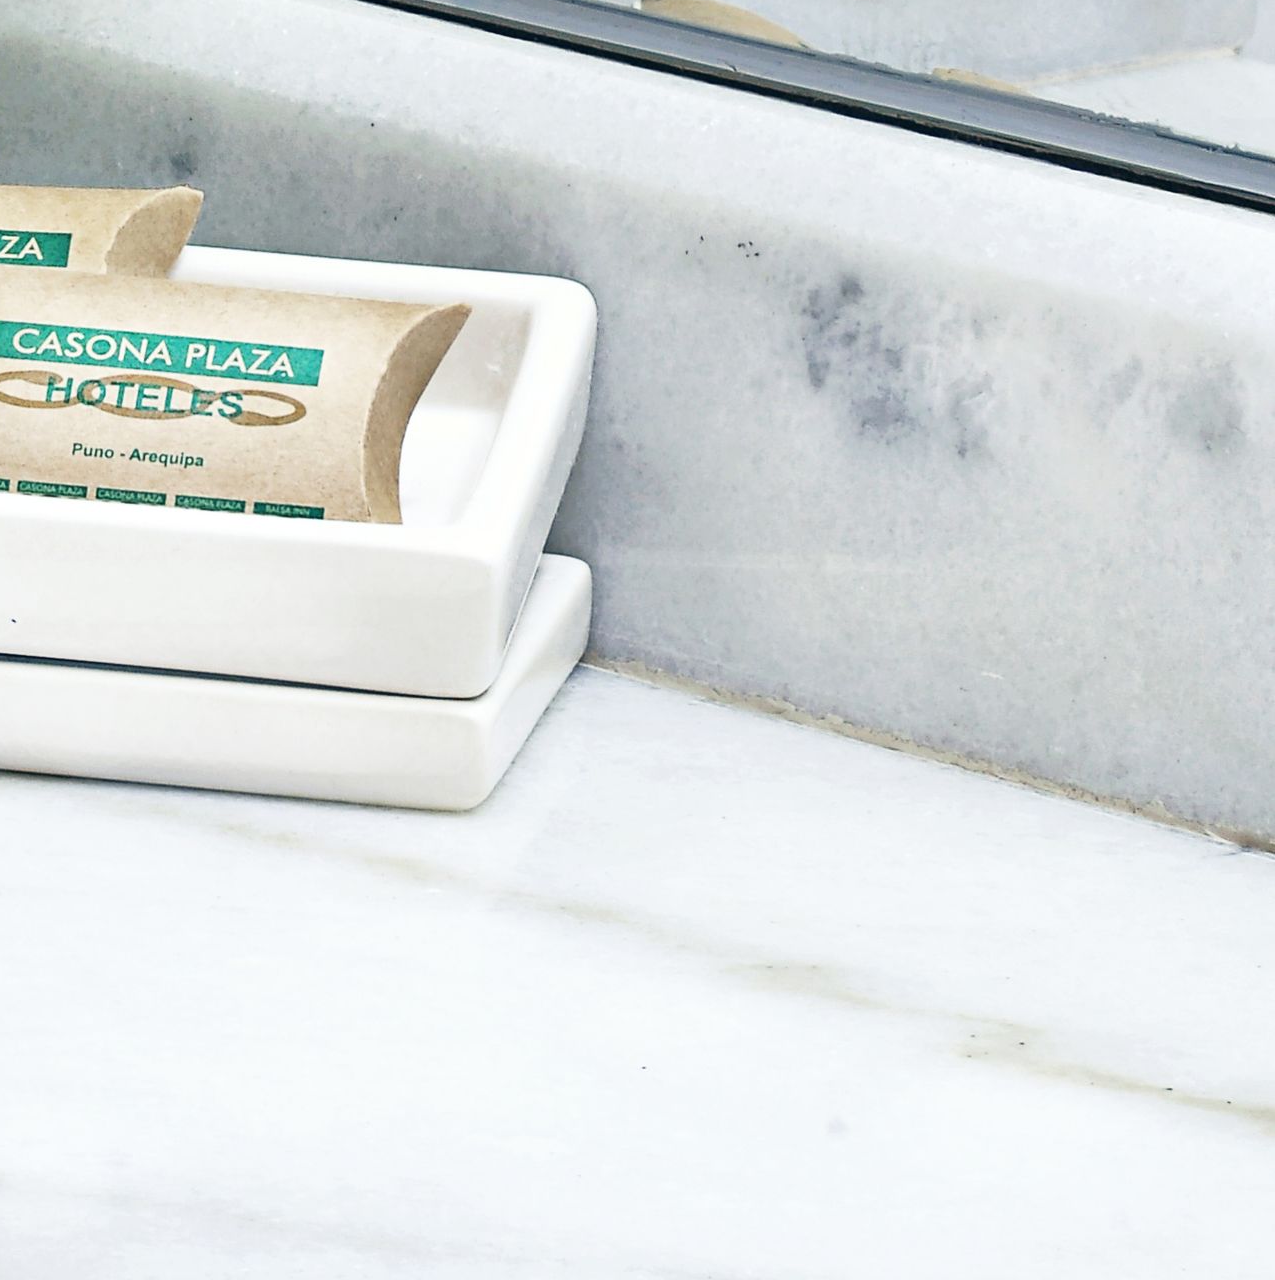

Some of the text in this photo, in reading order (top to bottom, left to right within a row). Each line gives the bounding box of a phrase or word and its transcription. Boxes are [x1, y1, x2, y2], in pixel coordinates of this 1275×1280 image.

[12, 328, 295, 378] CASONA PLAZA
[45, 376, 244, 419] HOTELES
[71, 443, 114, 459] Puno
[129, 447, 204, 468] Arequipa
[19, 482, 84, 495] CASONA PLAZA
[98, 489, 135, 501] CASONA
[177, 496, 215, 508] CASONA
